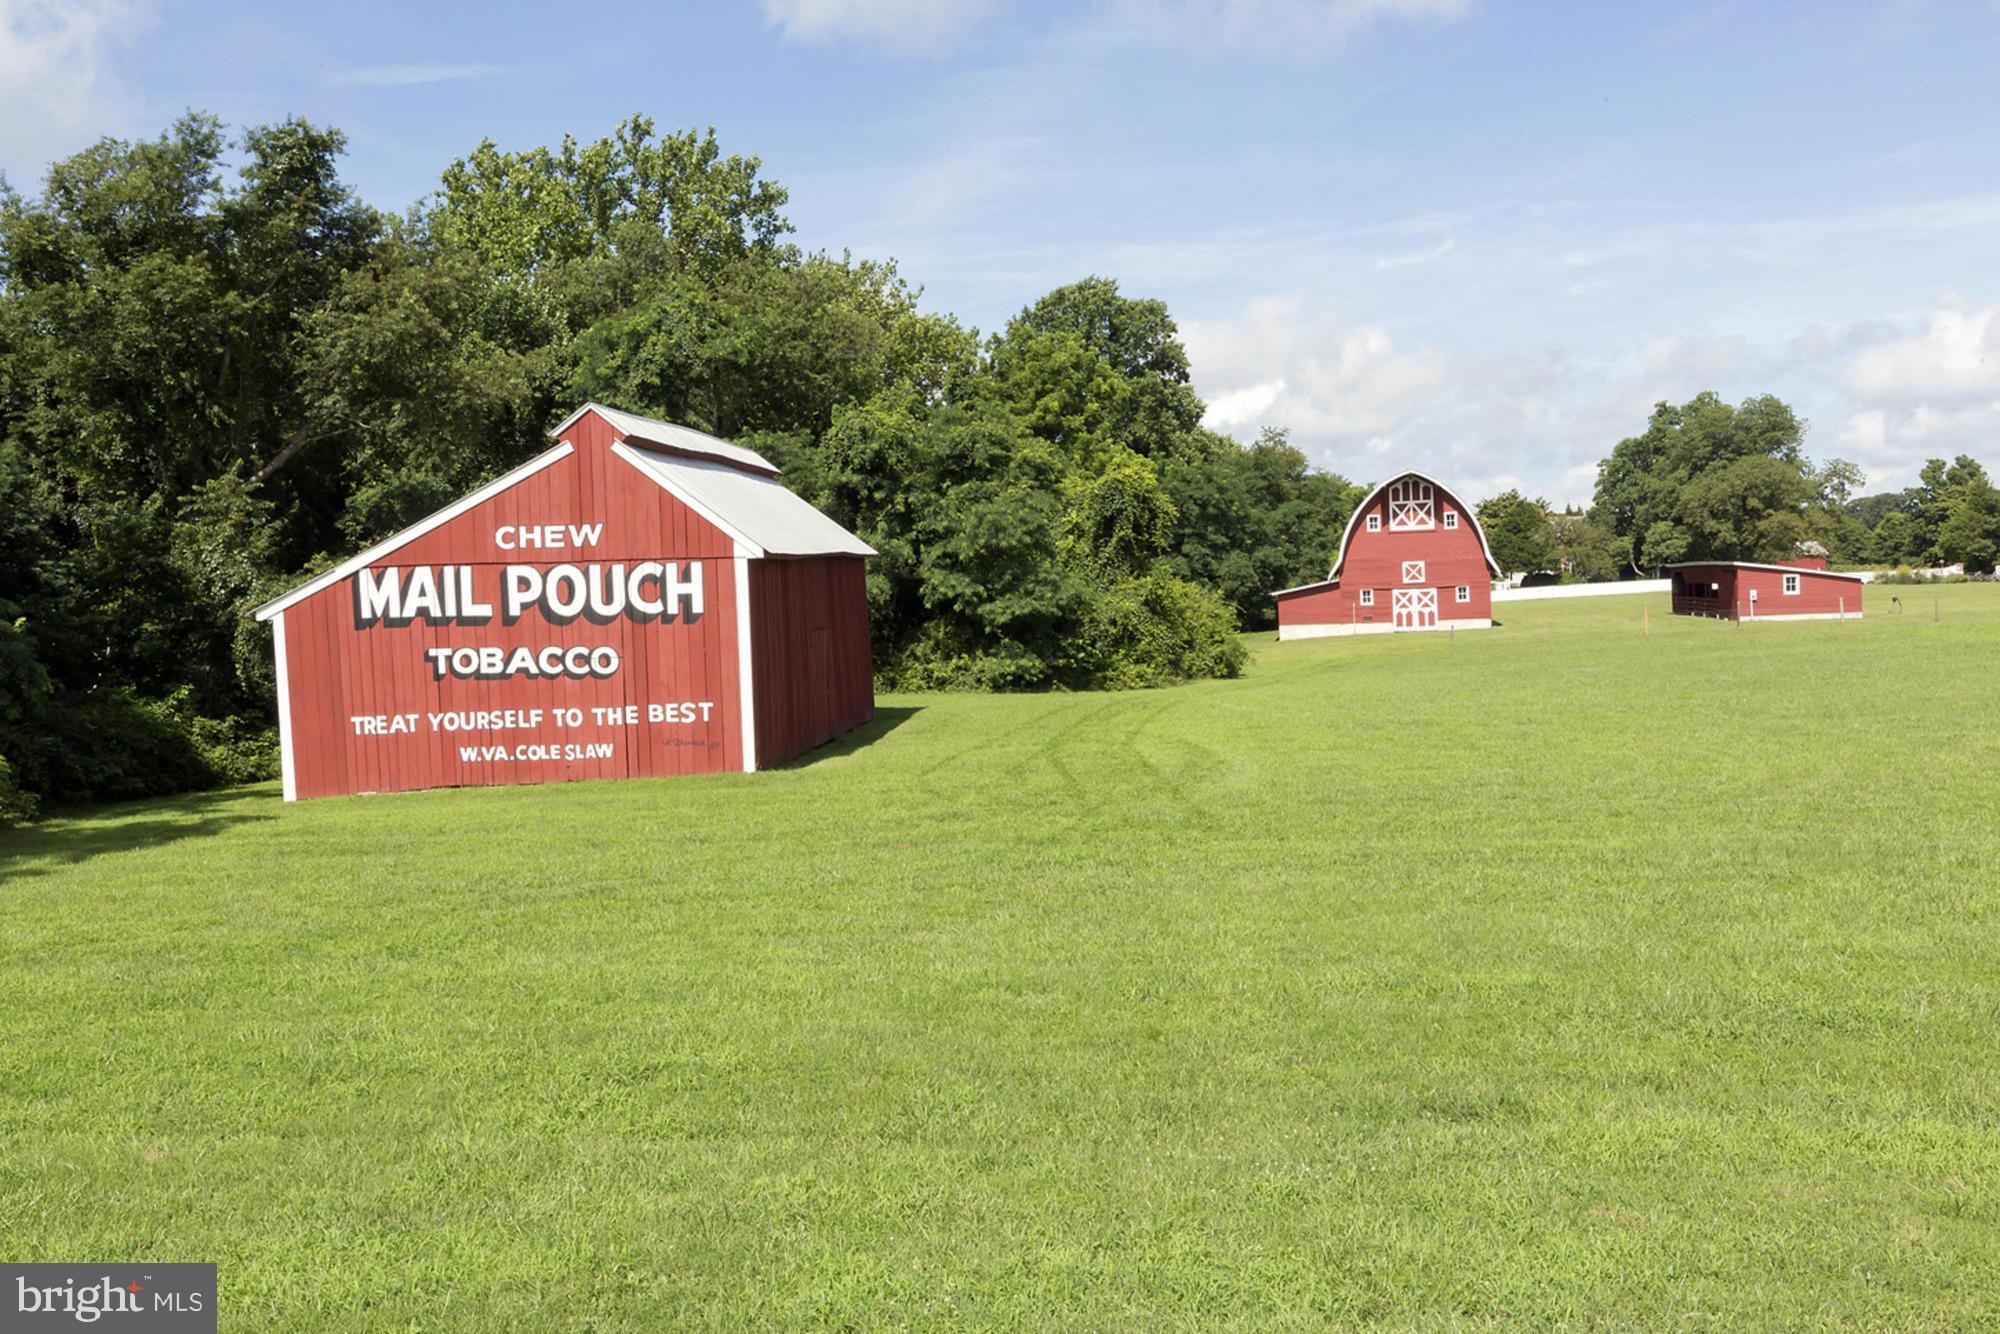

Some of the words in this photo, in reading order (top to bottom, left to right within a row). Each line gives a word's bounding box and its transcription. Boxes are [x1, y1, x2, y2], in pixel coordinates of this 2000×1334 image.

[495, 523, 603, 550] CHEW
[357, 564, 494, 621] MAIL
[506, 560, 705, 619] POUCH
[428, 646, 620, 676] TOBACCO
[350, 713, 420, 736] TREAT
[427, 708, 544, 732] YOURSELF
[552, 707, 584, 728] TO
[590, 705, 639, 727] THE
[647, 701, 714, 724] BEST
[564, 743, 614, 761] SLAW
